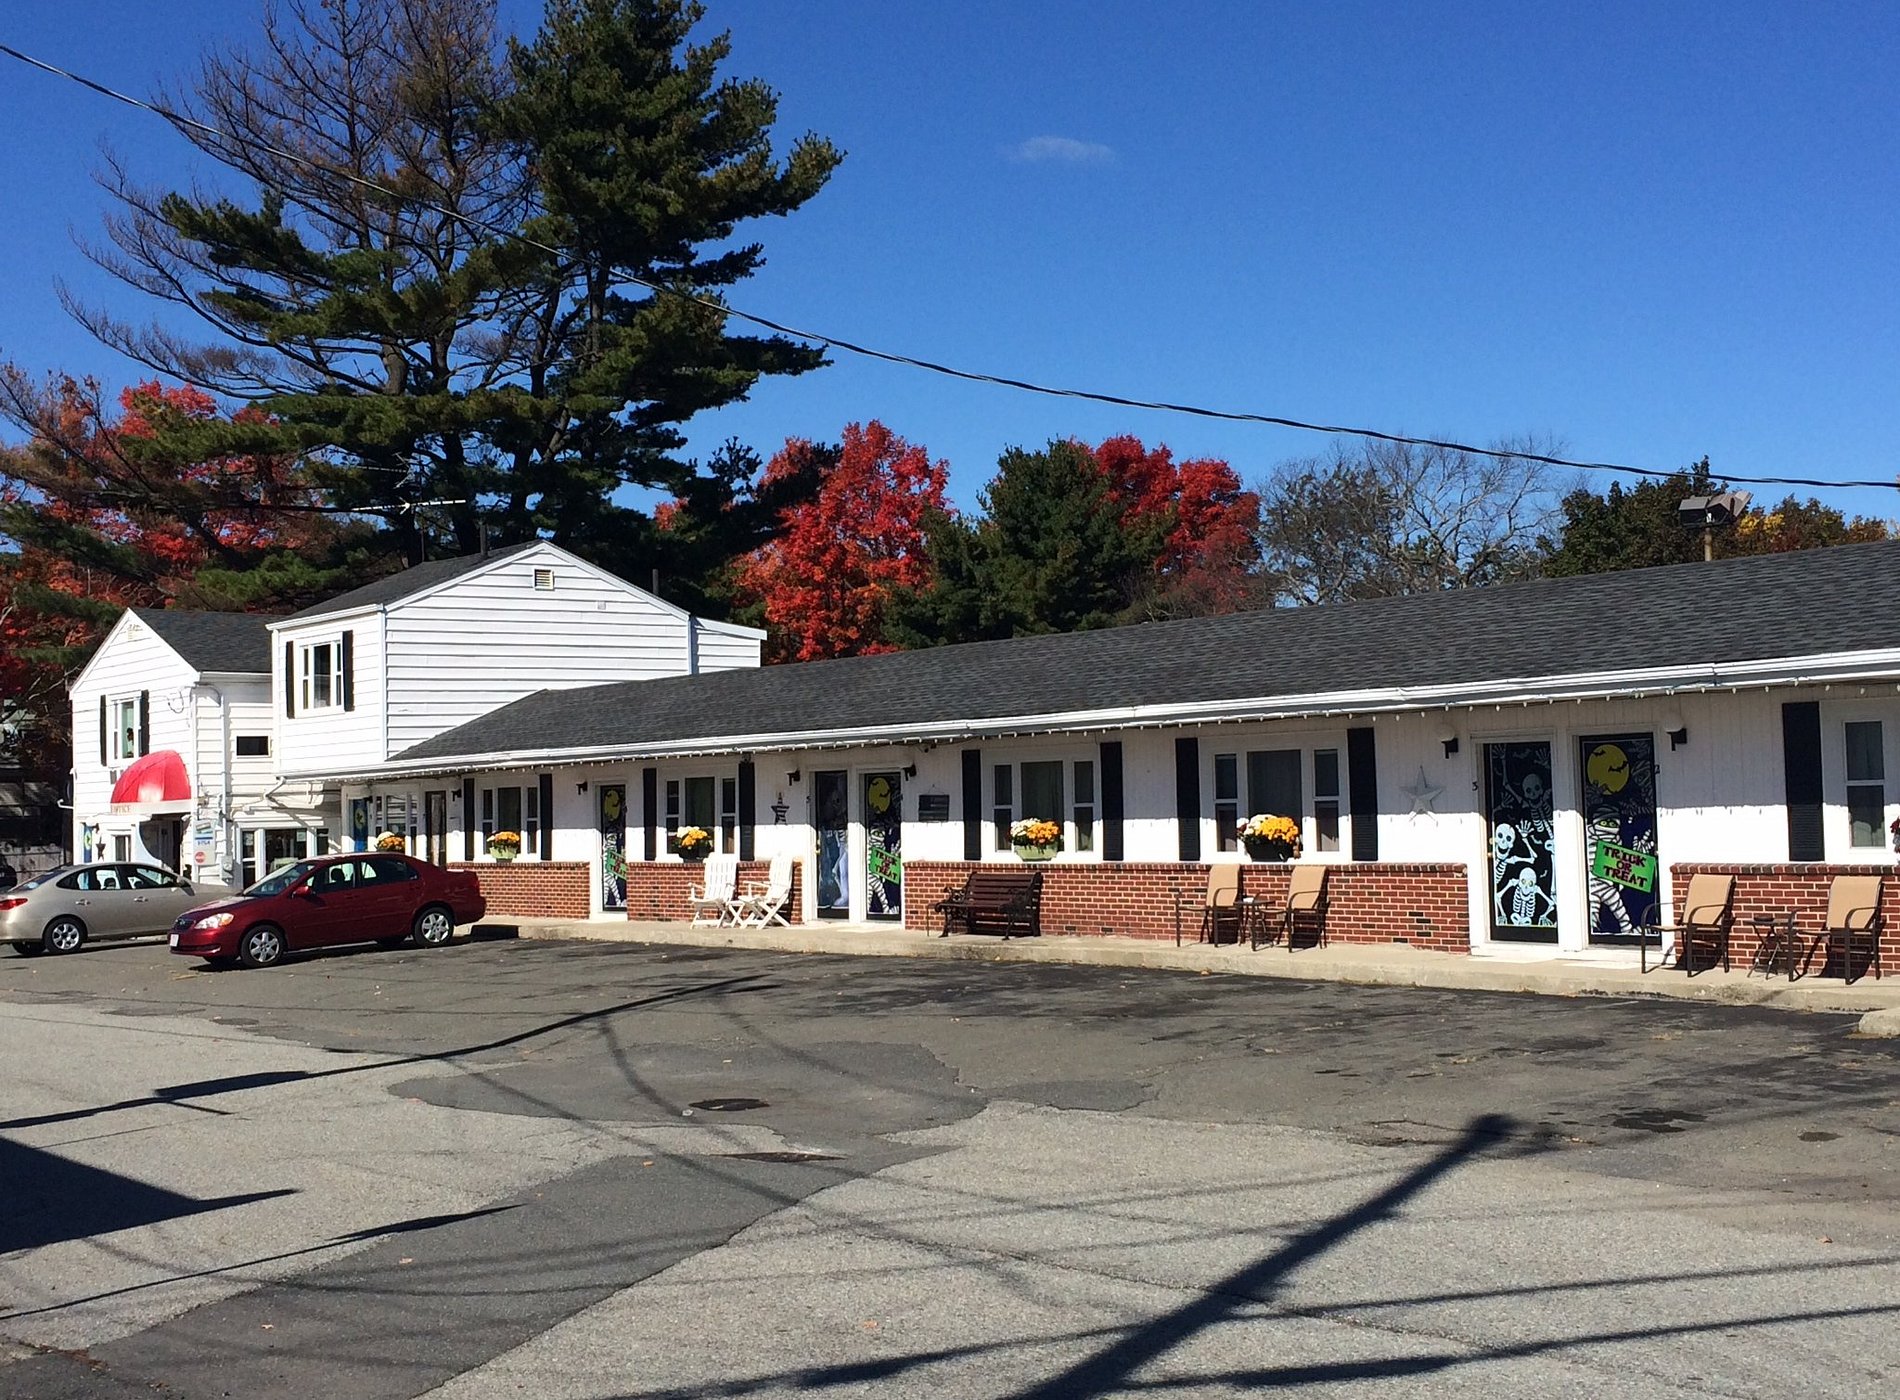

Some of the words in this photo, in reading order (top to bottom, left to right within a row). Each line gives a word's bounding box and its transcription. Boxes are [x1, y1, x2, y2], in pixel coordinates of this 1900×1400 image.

[1602, 845, 1647, 867] TRICK
[1616, 860, 1632, 872] OR
[1603, 865, 1647, 888] TREAT
